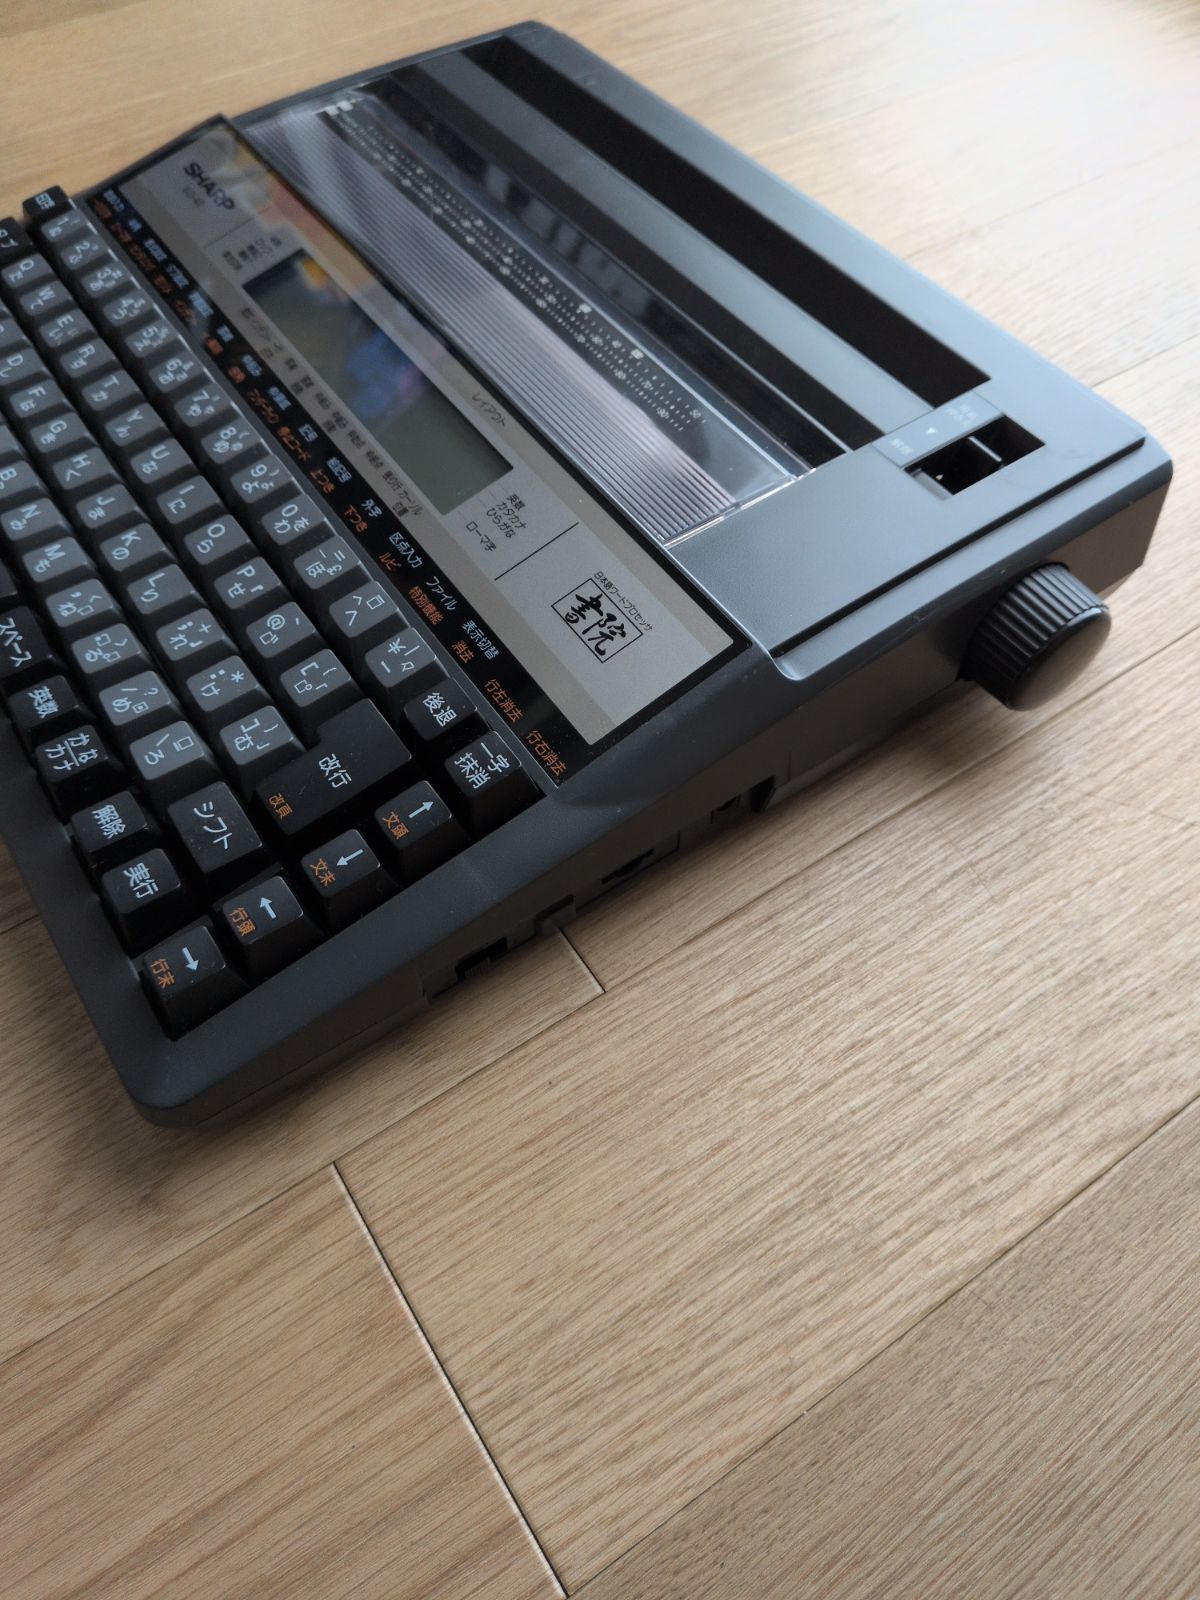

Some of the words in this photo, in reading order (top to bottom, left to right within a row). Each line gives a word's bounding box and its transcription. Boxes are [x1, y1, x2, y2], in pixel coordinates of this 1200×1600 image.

[184, 162, 235, 210] SHARP
[75, 241, 91, 254] 2
[20, 260, 34, 272] Q
[96, 267, 112, 280] 3
[39, 286, 56, 300] W
[57, 314, 74, 328] E
[142, 325, 159, 338] 5
[79, 344, 95, 358] R
[7, 353, 24, 367] D
[165, 357, 182, 371] 6
[103, 375, 120, 388] T
[28, 385, 46, 397] F
[192, 390, 210, 402] 7
[127, 410, 144, 422] Y
[50, 420, 67, 434] G
[220, 426, 237, 439] 8
[151, 444, 171, 461] U
[72, 454, 91, 469] H
[0, 467, 17, 481] B
[250, 464, 268, 477] 9
[241, 481, 260, 494] よ
[96, 496, 116, 506] J
[360, 498, 383, 518] 外字
[506, 492, 526, 511] 英数
[20, 504, 41, 519] N
[281, 503, 299, 517] 0
[496, 501, 527, 530] カタカナ
[273, 518, 291, 534] わ
[293, 516, 310, 532] を
[343, 504, 368, 534] 下つき
[486, 506, 516, 539] ひらがな
[121, 530, 142, 547] K
[207, 523, 226, 539] O
[466, 521, 497, 552] ローマ字
[44, 543, 66, 560] M
[111, 546, 130, 560] の
[389, 531, 423, 568] 区点入力
[305, 561, 326, 578] ほ
[378, 552, 402, 571] ルビ
[147, 572, 165, 587] L
[236, 565, 256, 578] P
[140, 588, 159, 603] り
[227, 582, 247, 599] せ
[425, 575, 457, 611] ファイル
[57, 602, 77, 617] ね
[408, 585, 445, 625] 特別機能
[593, 570, 653, 632] 日本語ワードプロセッサ
[266, 614, 286, 630] @
[564, 592, 627, 656] 書院
[0, 617, 33, 667] スペース
[169, 633, 188, 650] れ
[388, 638, 407, 654] ¥
[461, 620, 500, 660] 表示切替
[85, 646, 103, 662] る
[451, 639, 476, 664] 消去
[200, 682, 222, 697] け
[28, 685, 59, 719] 英数
[111, 696, 130, 713] め
[483, 678, 524, 723] 行左消去
[422, 692, 457, 727] 後退
[68, 732, 99, 763] かな
[234, 733, 254, 752] む
[44, 743, 73, 771] カナ
[145, 750, 165, 765] ろ
[480, 742, 511, 773] 一字
[525, 730, 568, 777] 行右消去
[318, 753, 352, 789] 改行
[454, 752, 491, 789] 抹消
[268, 792, 295, 820] 改頁
[92, 804, 126, 839] 解除
[193, 800, 233, 850] シフト
[382, 810, 409, 840] 文頭
[123, 862, 160, 899] 実行
[309, 858, 337, 887] 文末
[229, 907, 256, 937] 行頭
[150, 958, 176, 989] 行末
